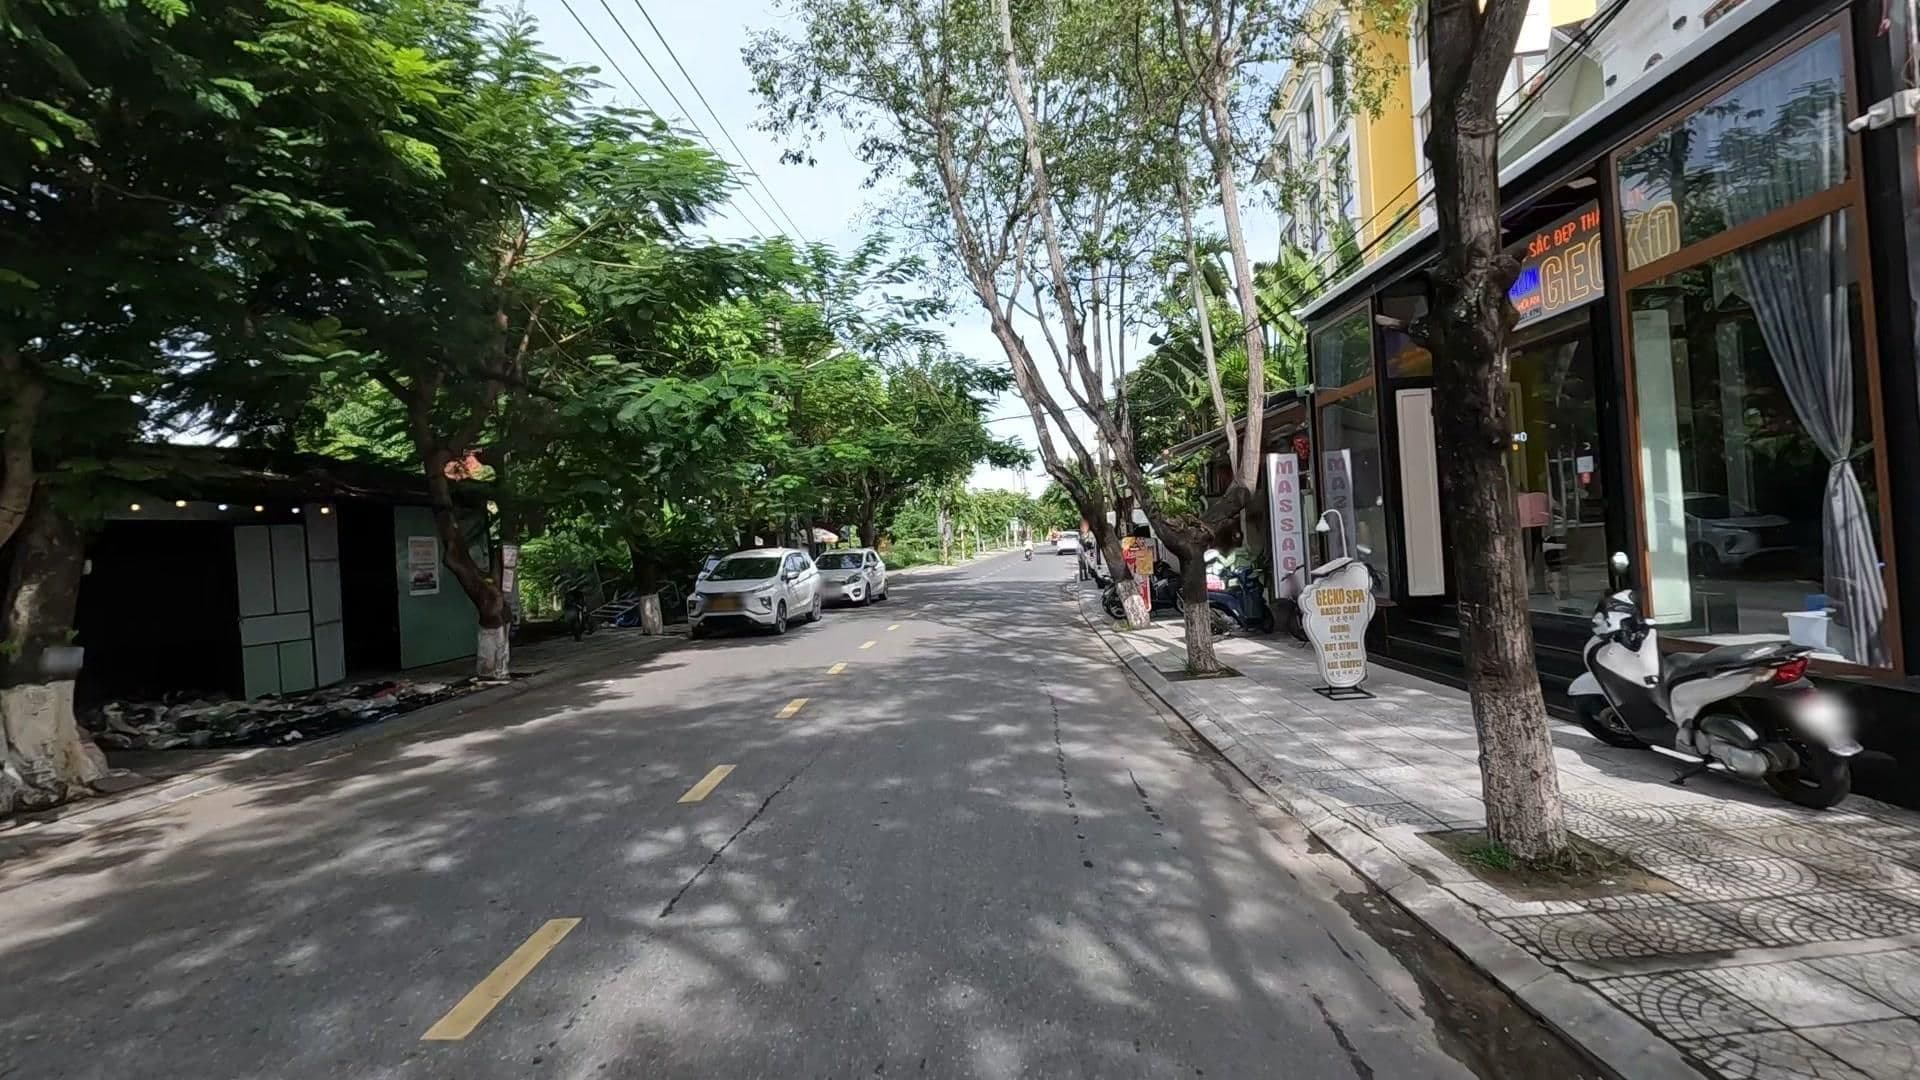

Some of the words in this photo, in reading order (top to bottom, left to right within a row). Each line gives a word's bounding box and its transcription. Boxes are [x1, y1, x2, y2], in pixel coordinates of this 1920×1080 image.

[1276, 460, 1299, 591] MASSAG
[1315, 588, 1345, 607] GECKO
[1346, 588, 1366, 604] SPA
[1320, 606, 1341, 616] BASIC
[1342, 604, 1361, 614] CARE
